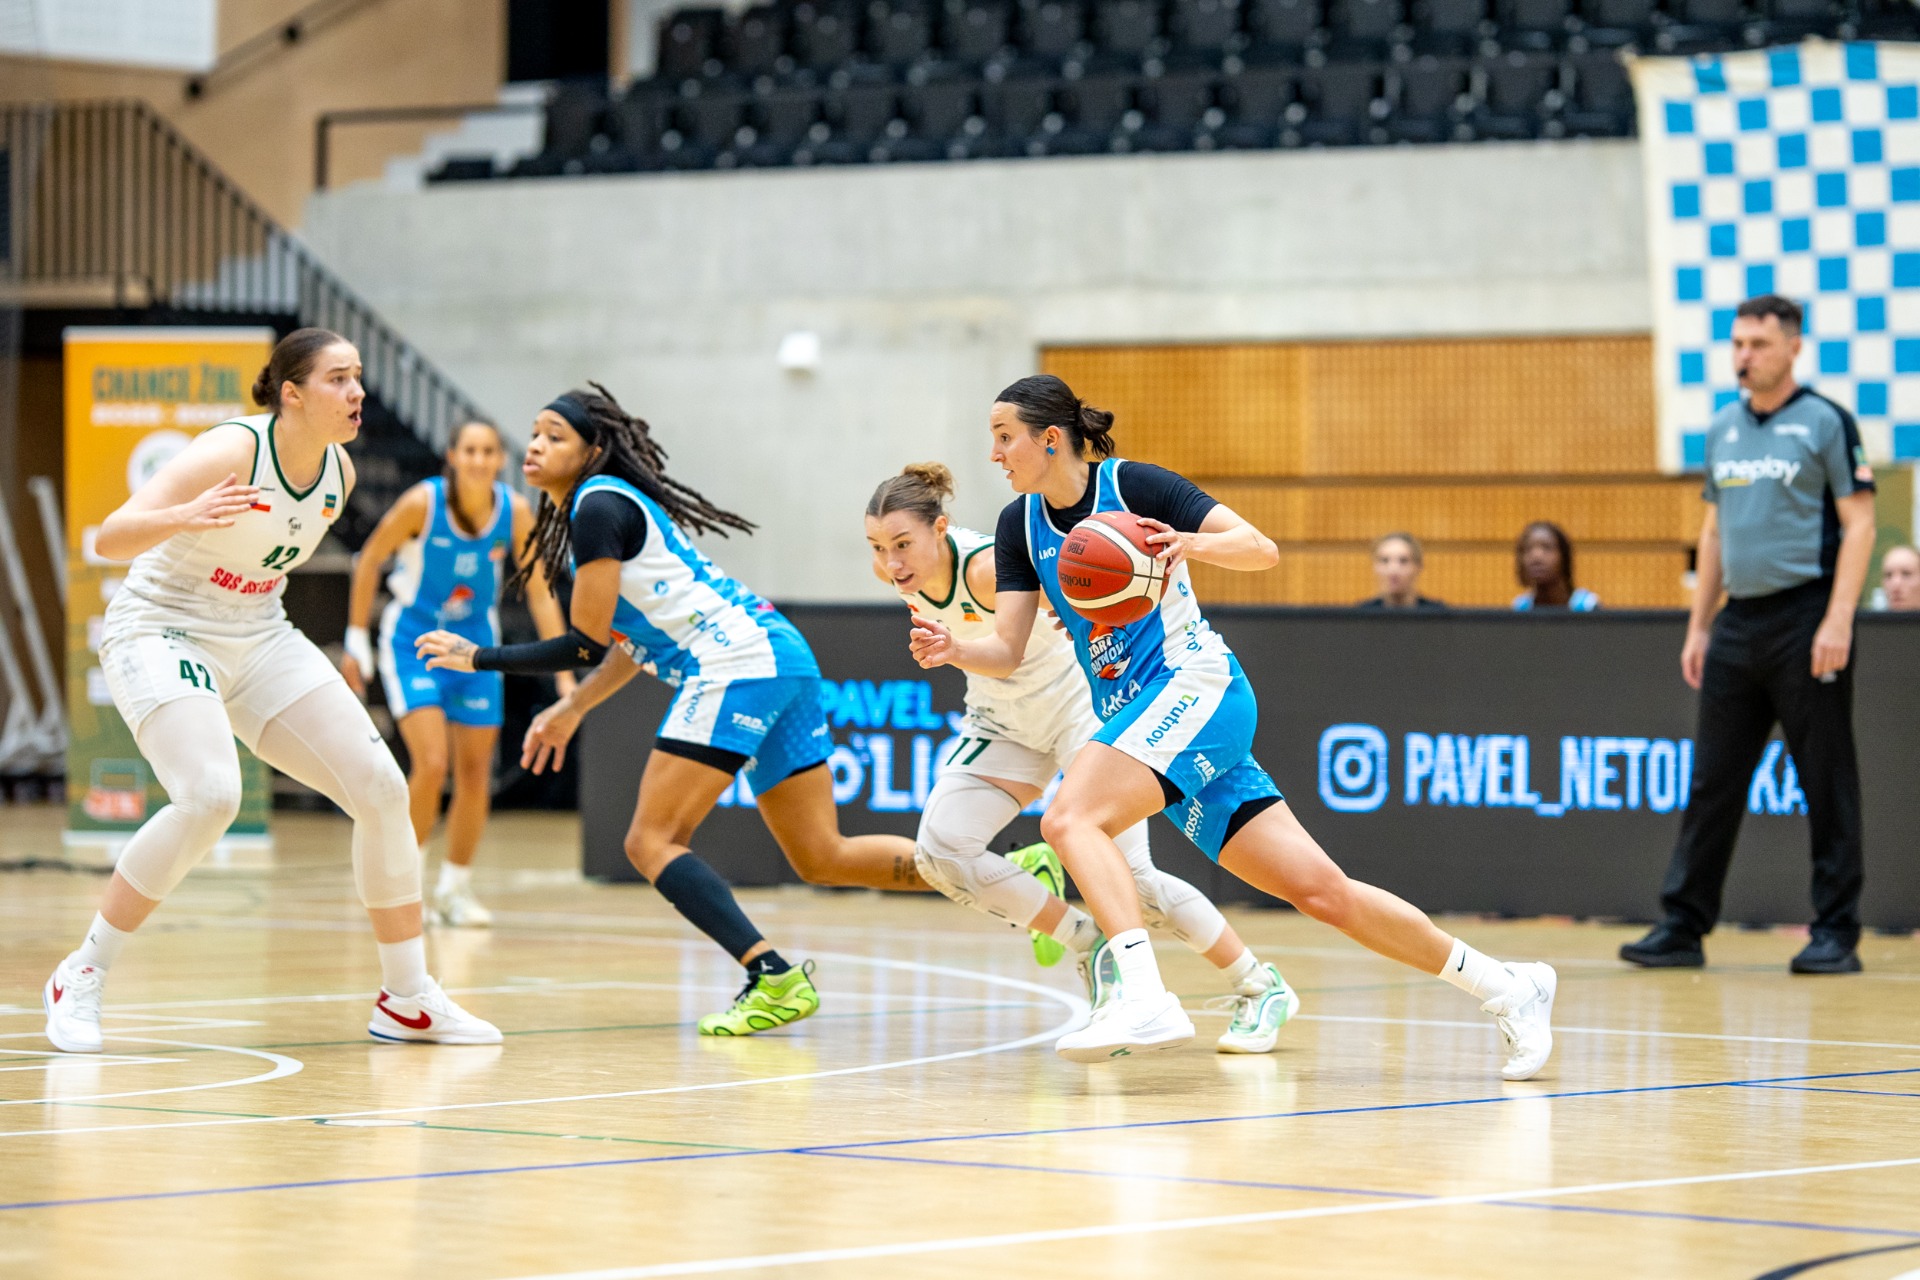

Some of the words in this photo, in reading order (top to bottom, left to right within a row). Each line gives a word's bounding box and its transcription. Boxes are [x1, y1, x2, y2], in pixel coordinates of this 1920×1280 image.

[262, 545, 301, 570] 42
[1059, 573, 1091, 588] molte
[179, 659, 217, 693] 42
[1145, 695, 1200, 747] Trutnov
[1403, 732, 1809, 817] PAVEL_NETOKA
